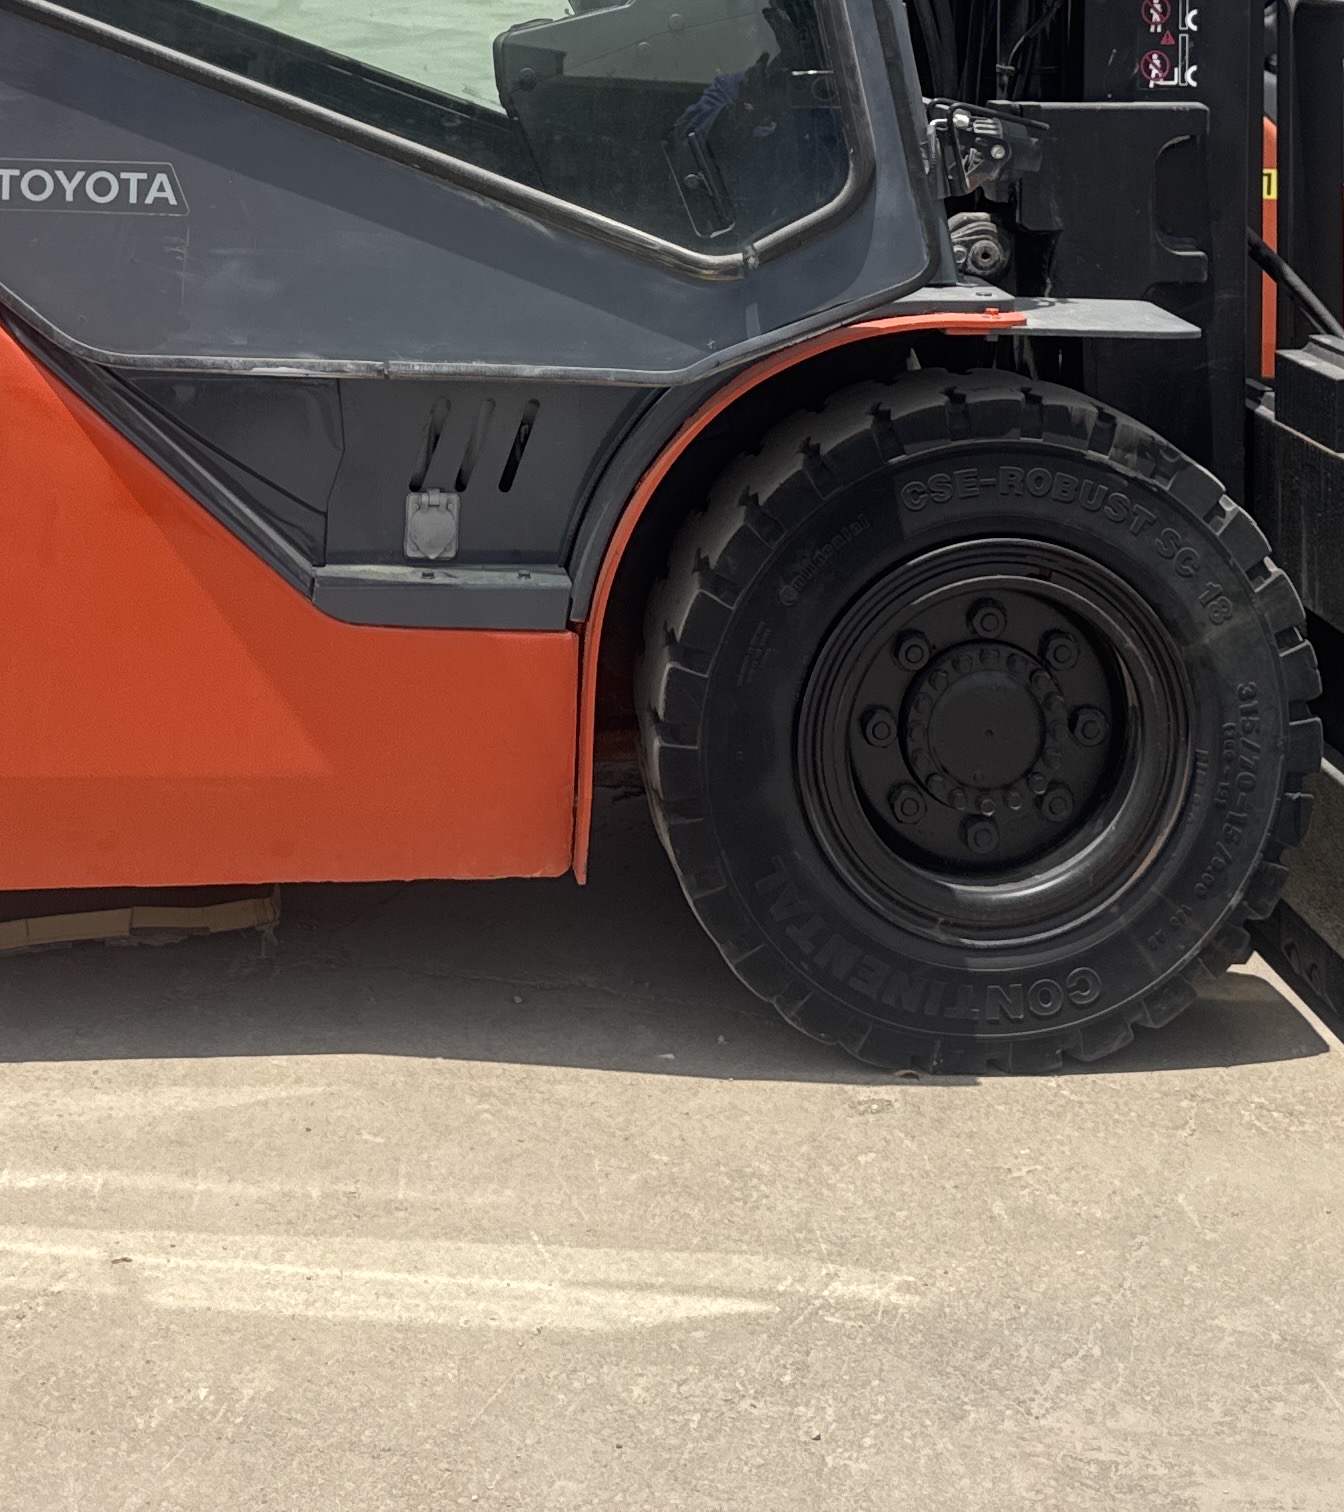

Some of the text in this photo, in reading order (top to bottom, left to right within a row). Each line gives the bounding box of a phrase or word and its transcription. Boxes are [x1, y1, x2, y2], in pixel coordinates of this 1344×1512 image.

[901, 465, 1233, 626] CSE-ROBUST SC 18
[753, 853, 1104, 1026] CONTINENTAL
